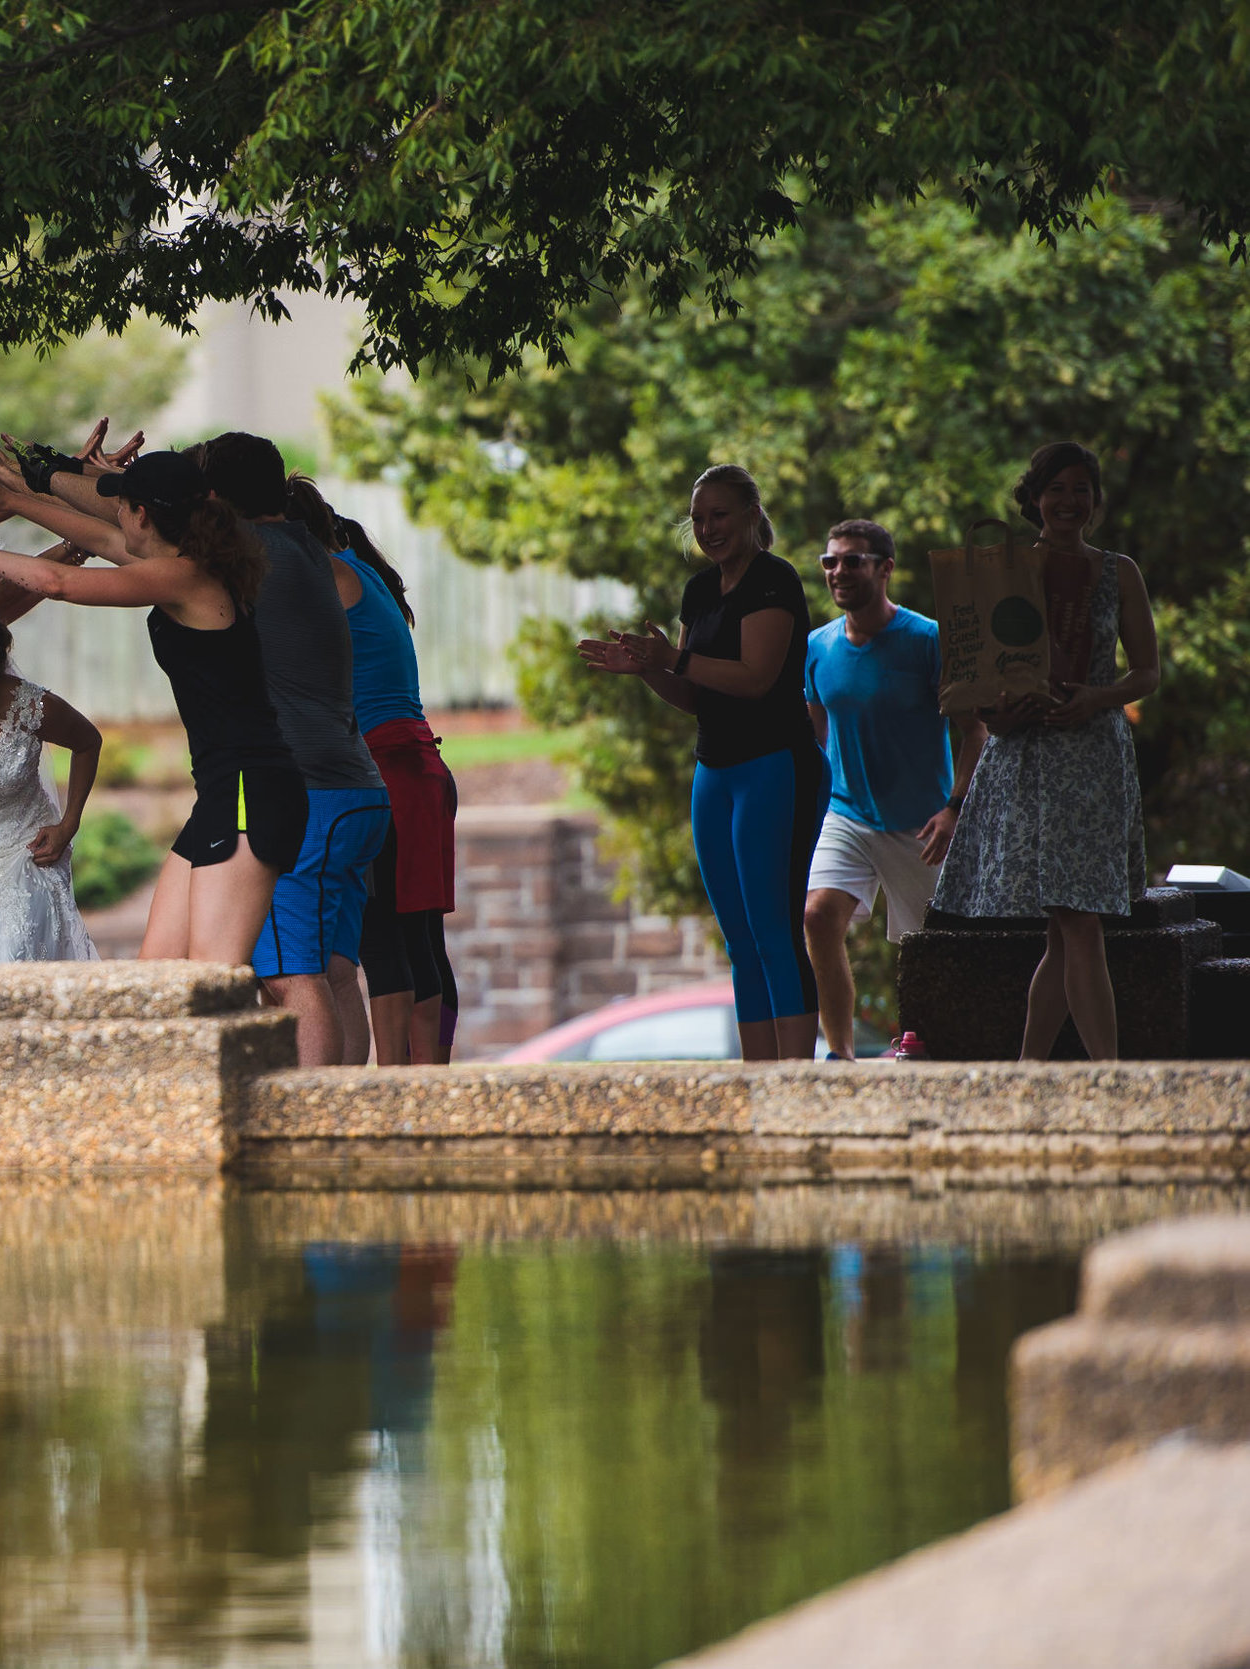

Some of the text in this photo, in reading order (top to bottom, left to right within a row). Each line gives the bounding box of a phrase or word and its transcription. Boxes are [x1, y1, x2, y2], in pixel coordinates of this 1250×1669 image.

[953, 599, 976, 617] Feel
[948, 614, 970, 632] Like
[948, 627, 980, 646] Guest
[951, 656, 976, 671] Own
